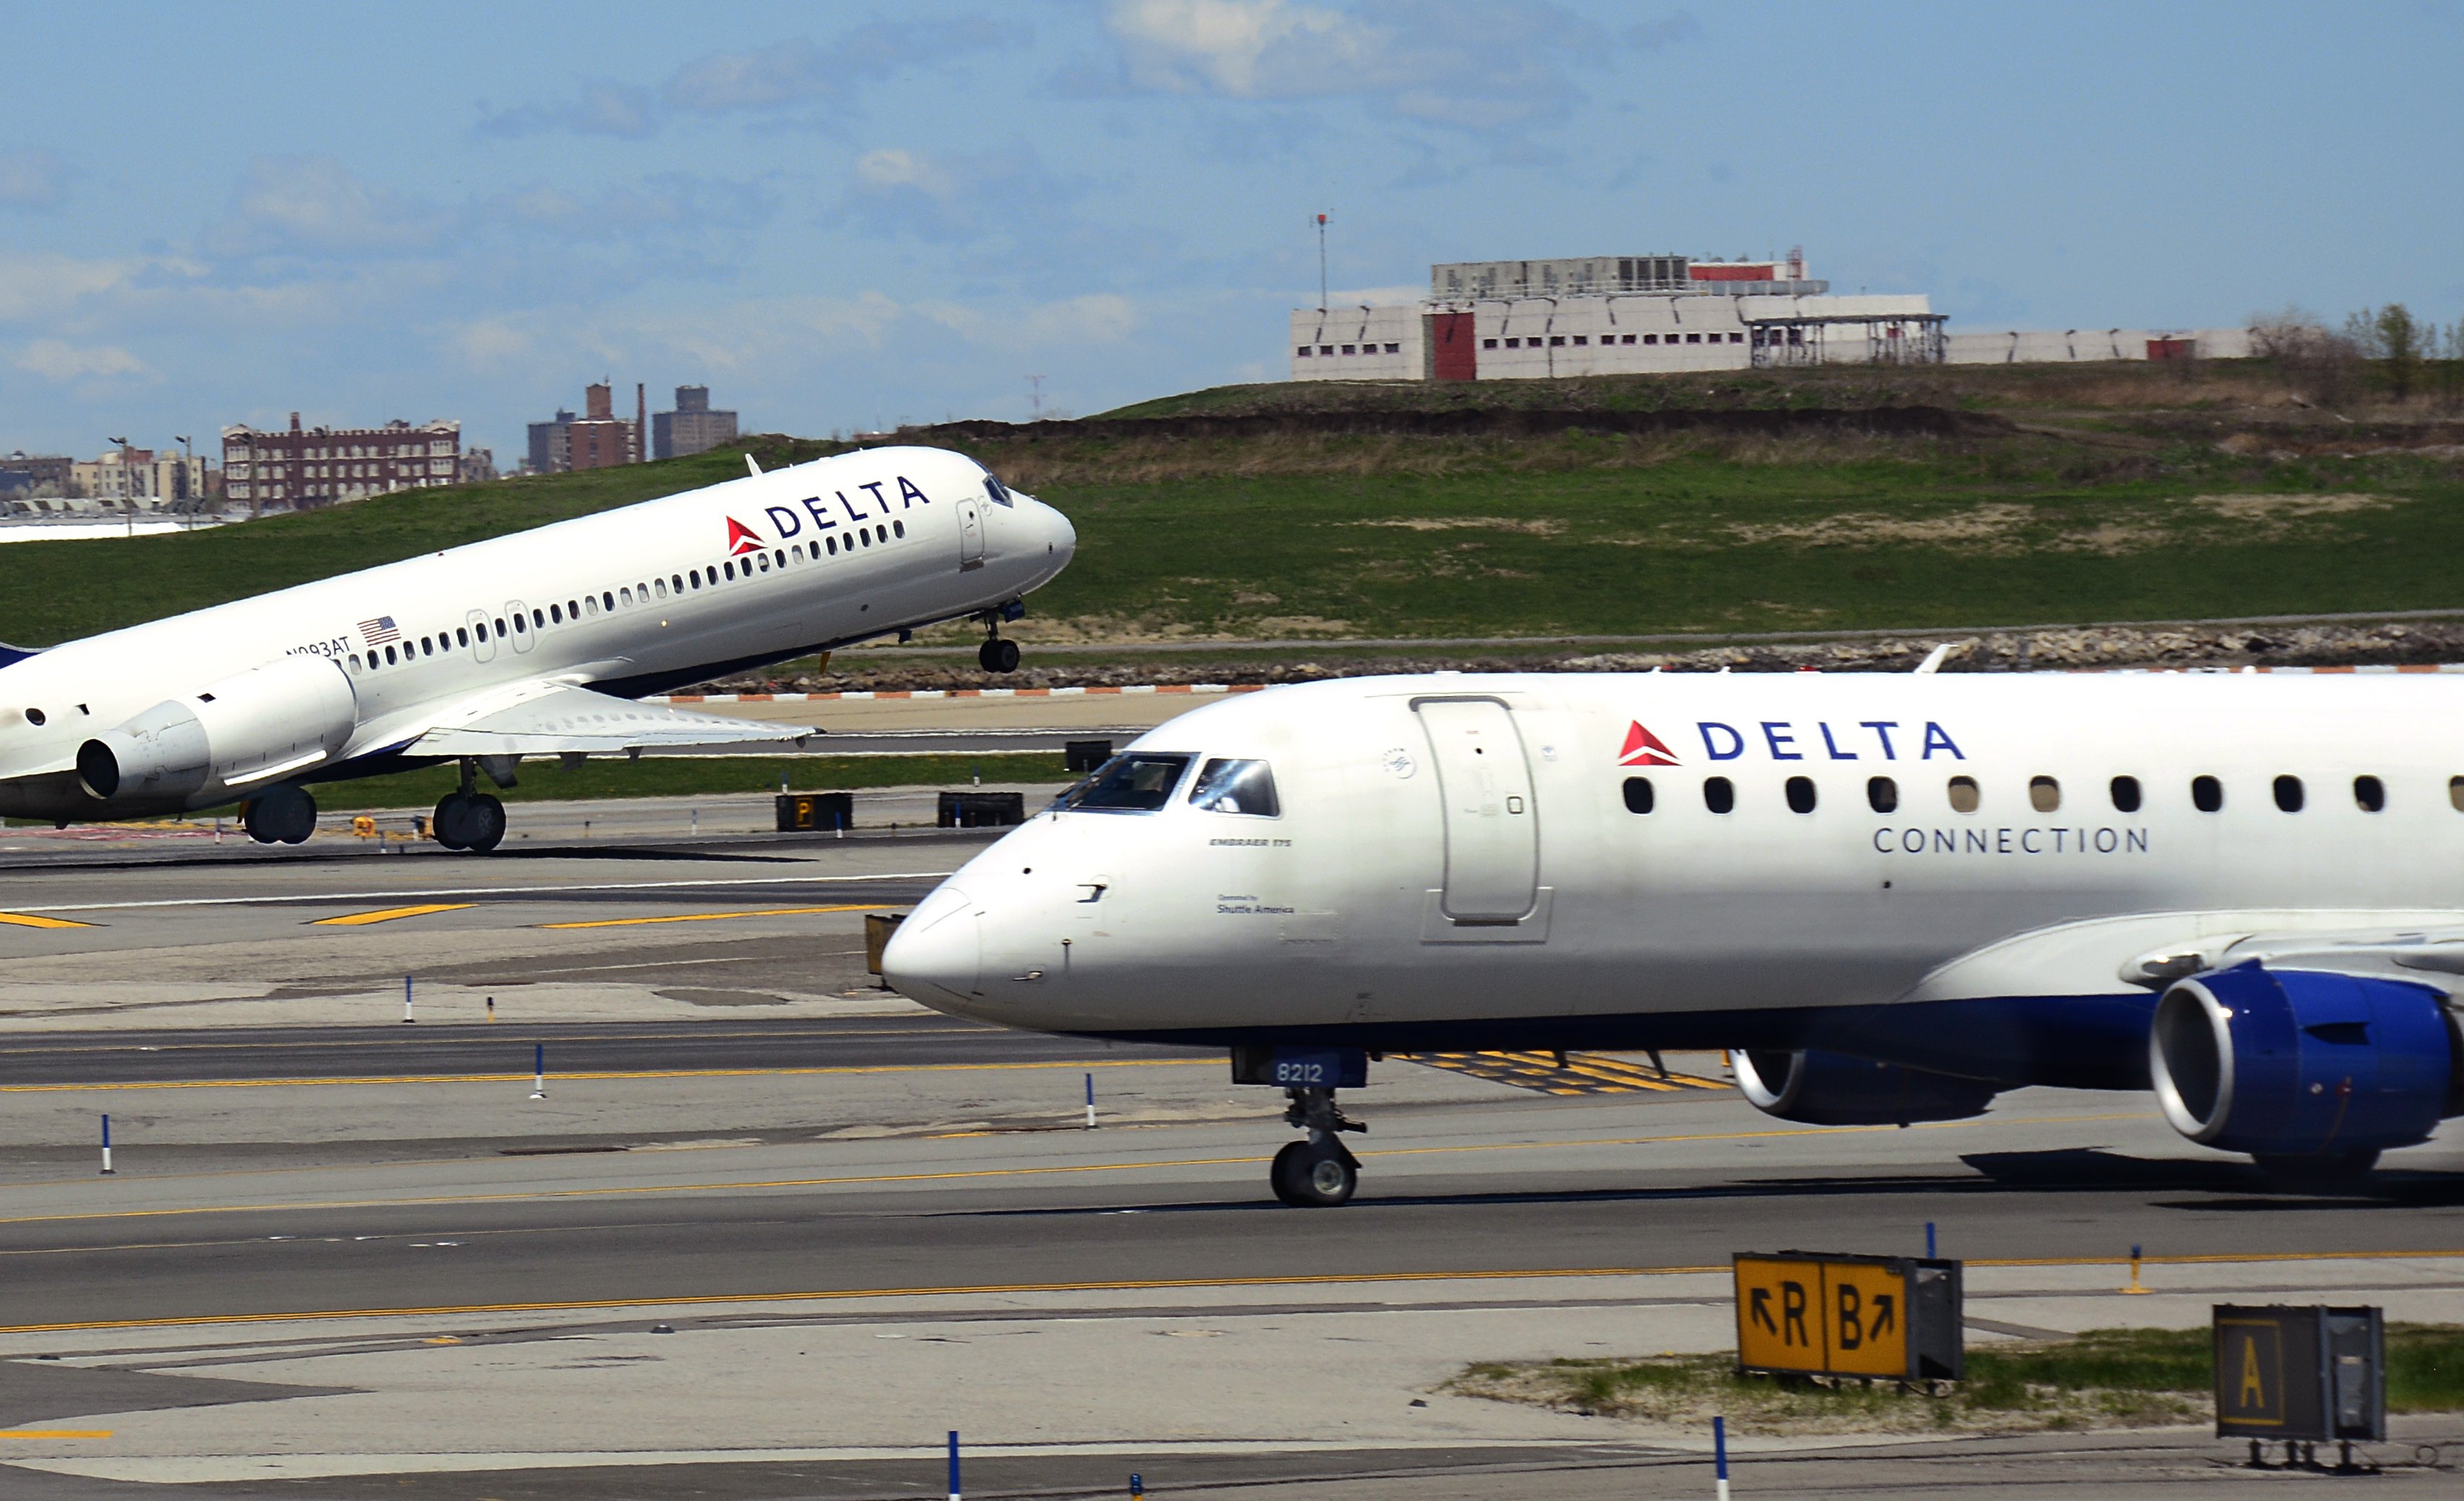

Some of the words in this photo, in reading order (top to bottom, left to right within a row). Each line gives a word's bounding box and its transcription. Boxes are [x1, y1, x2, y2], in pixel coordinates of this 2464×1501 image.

[764, 475, 930, 539] DELTA
[1696, 721, 1966, 760] DELTA
[799, 802, 810, 822] P
[1874, 828, 2149, 854] CONNECTION
[1277, 1063, 1323, 1082] 8212
[1780, 1281, 1808, 1347] R
[1838, 1283, 1862, 1351] B
[2240, 1336, 2265, 1408] A
